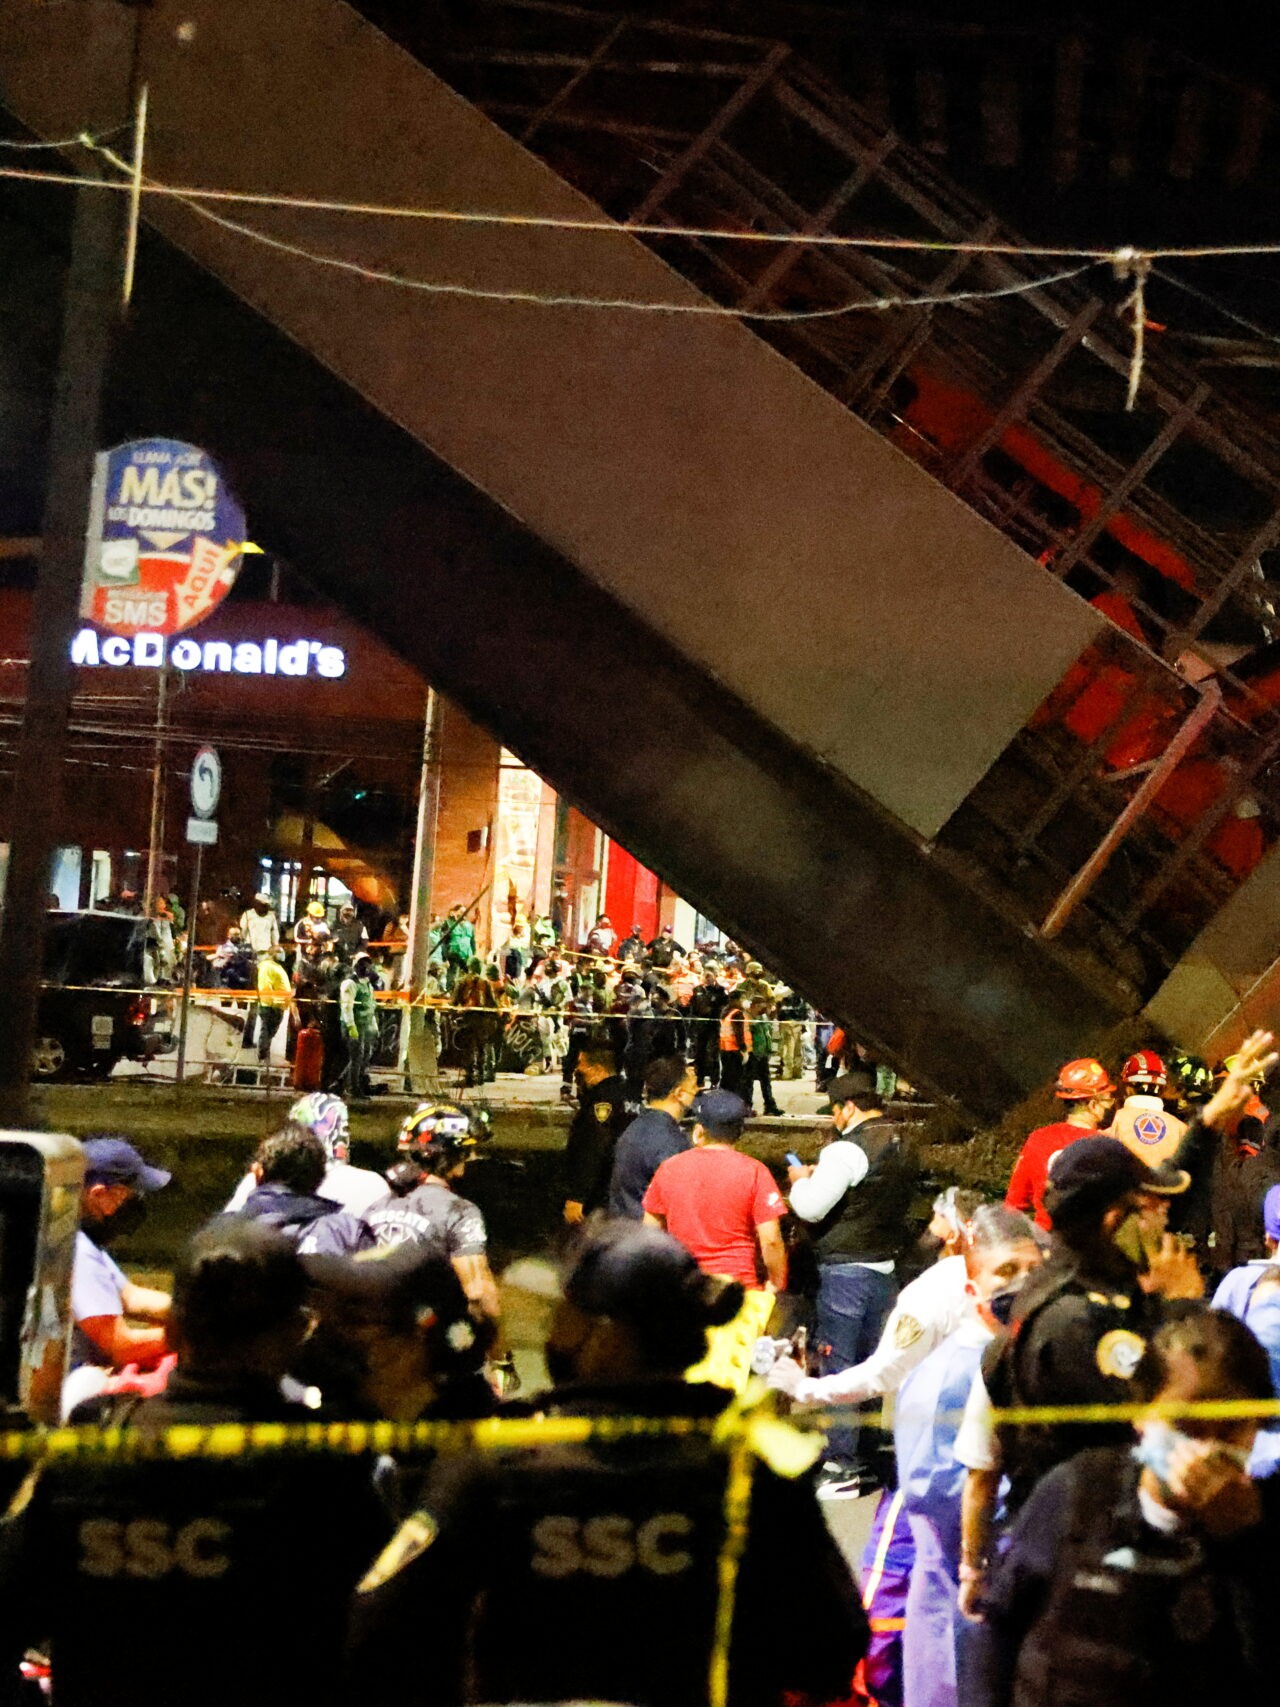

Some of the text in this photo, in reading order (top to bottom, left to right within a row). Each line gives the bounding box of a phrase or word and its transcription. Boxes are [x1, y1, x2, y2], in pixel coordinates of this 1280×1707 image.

[105, 599, 168, 626] SMS
[78, 1516, 232, 1579] SSC
[530, 1512, 695, 1577] SSC
